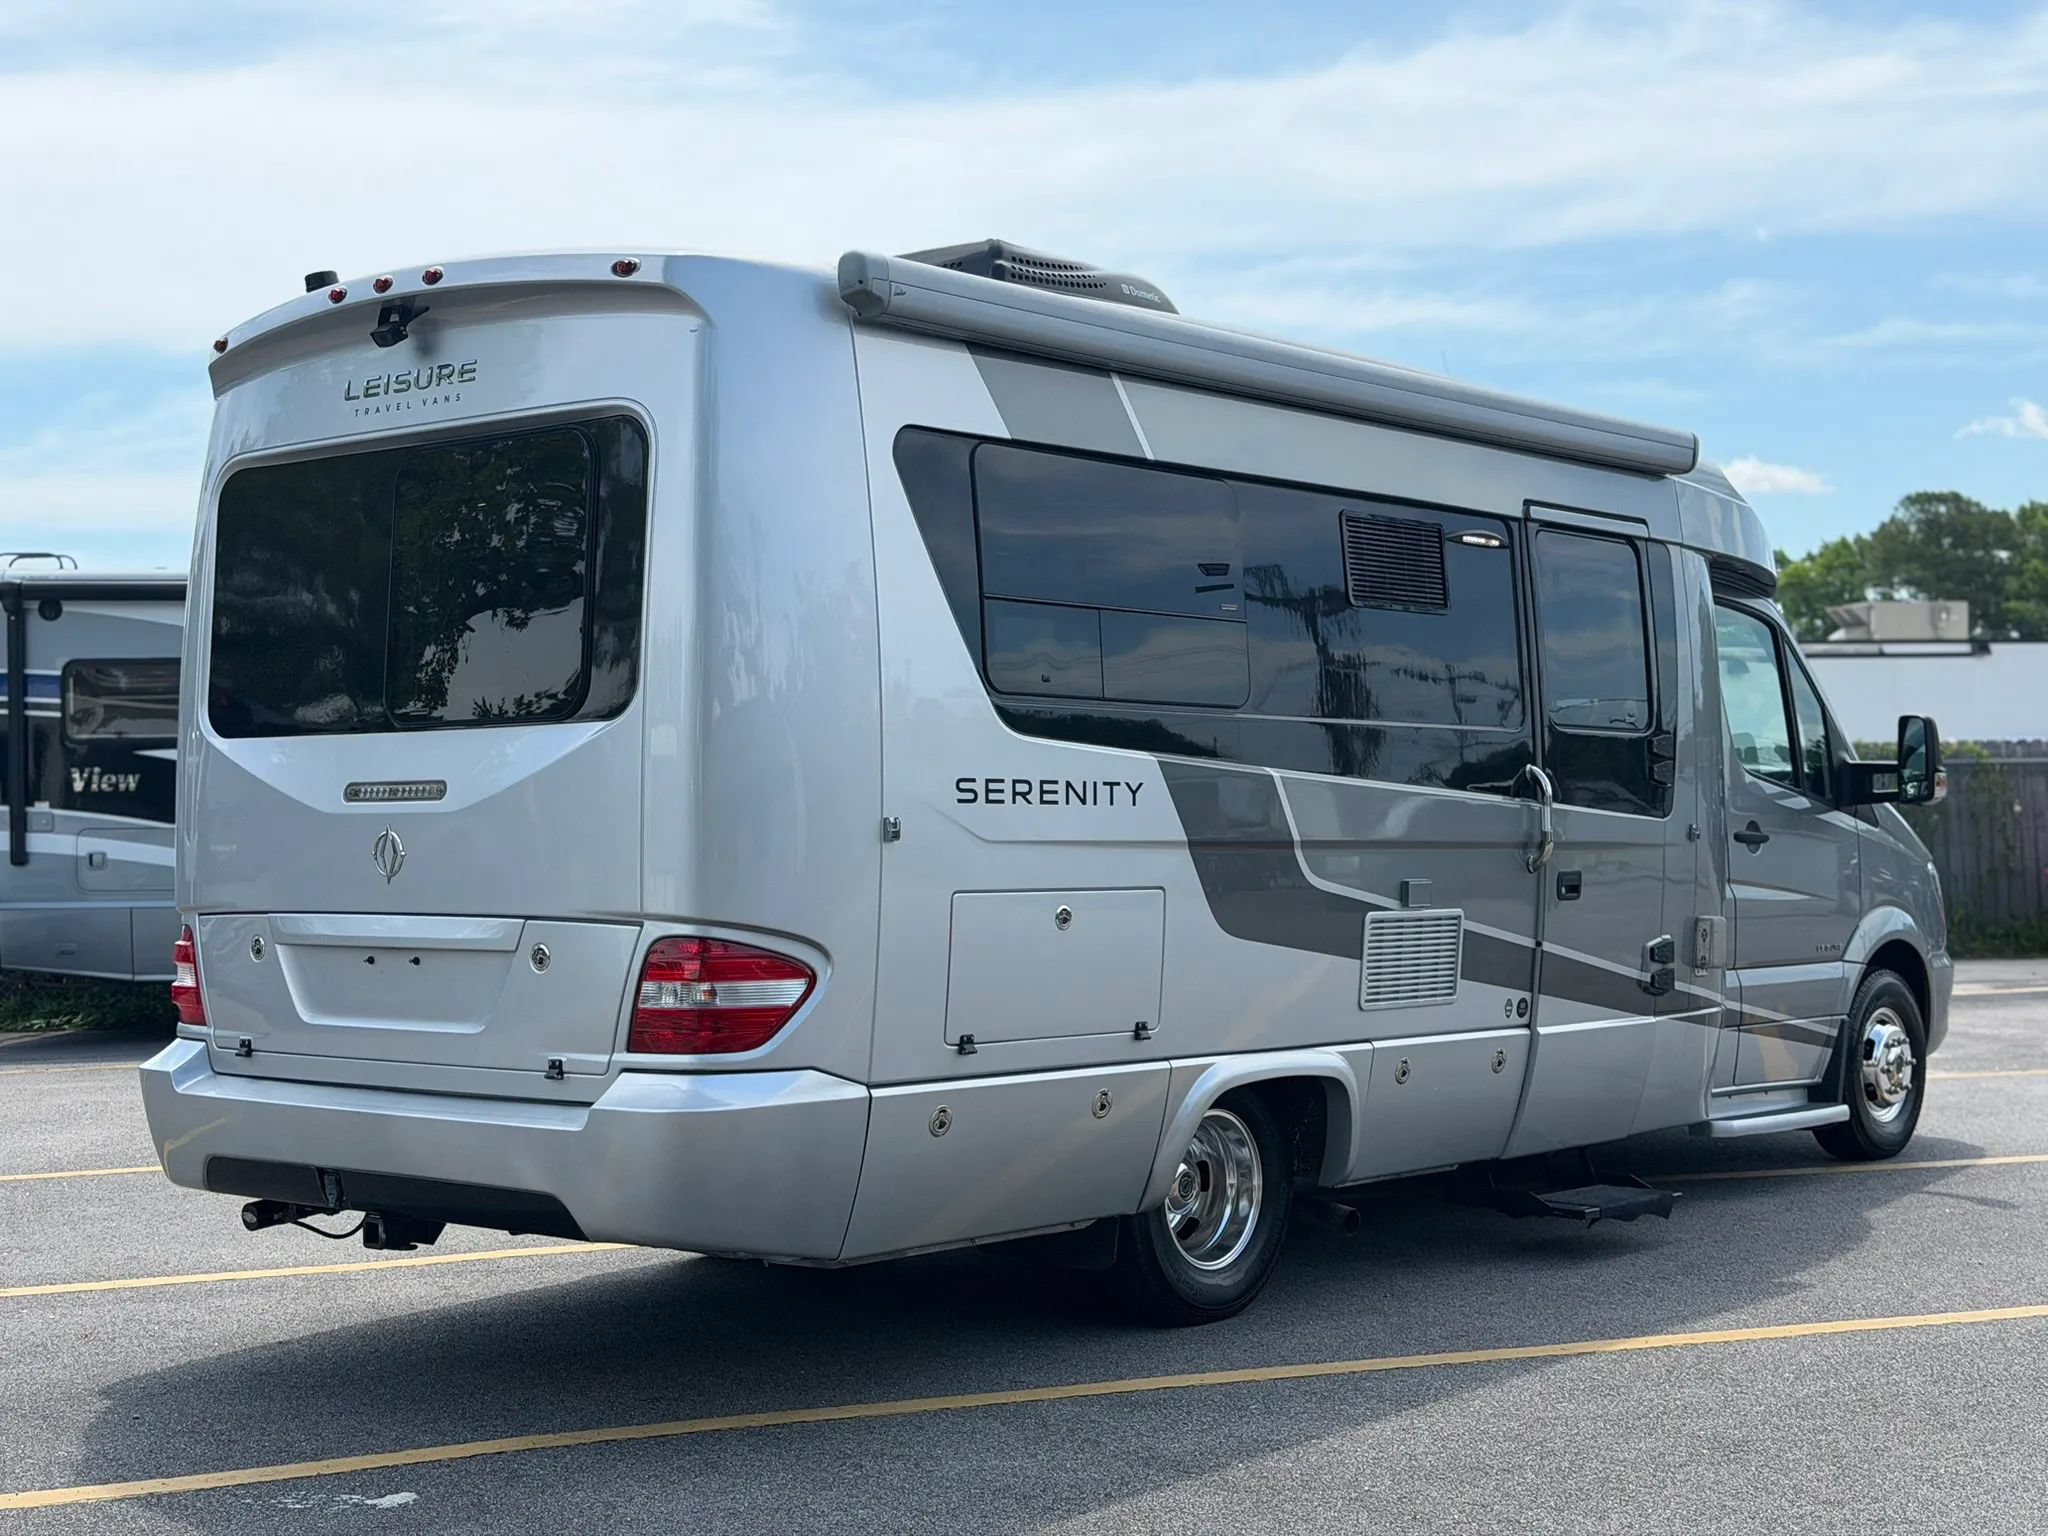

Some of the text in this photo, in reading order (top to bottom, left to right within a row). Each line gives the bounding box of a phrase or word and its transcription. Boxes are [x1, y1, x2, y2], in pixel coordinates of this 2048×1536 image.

[344, 359, 477, 401] LEISURE
[354, 393, 461, 417] TRAVEL VANS
[70, 766, 141, 792] View
[955, 777, 1144, 807] SERENITY
